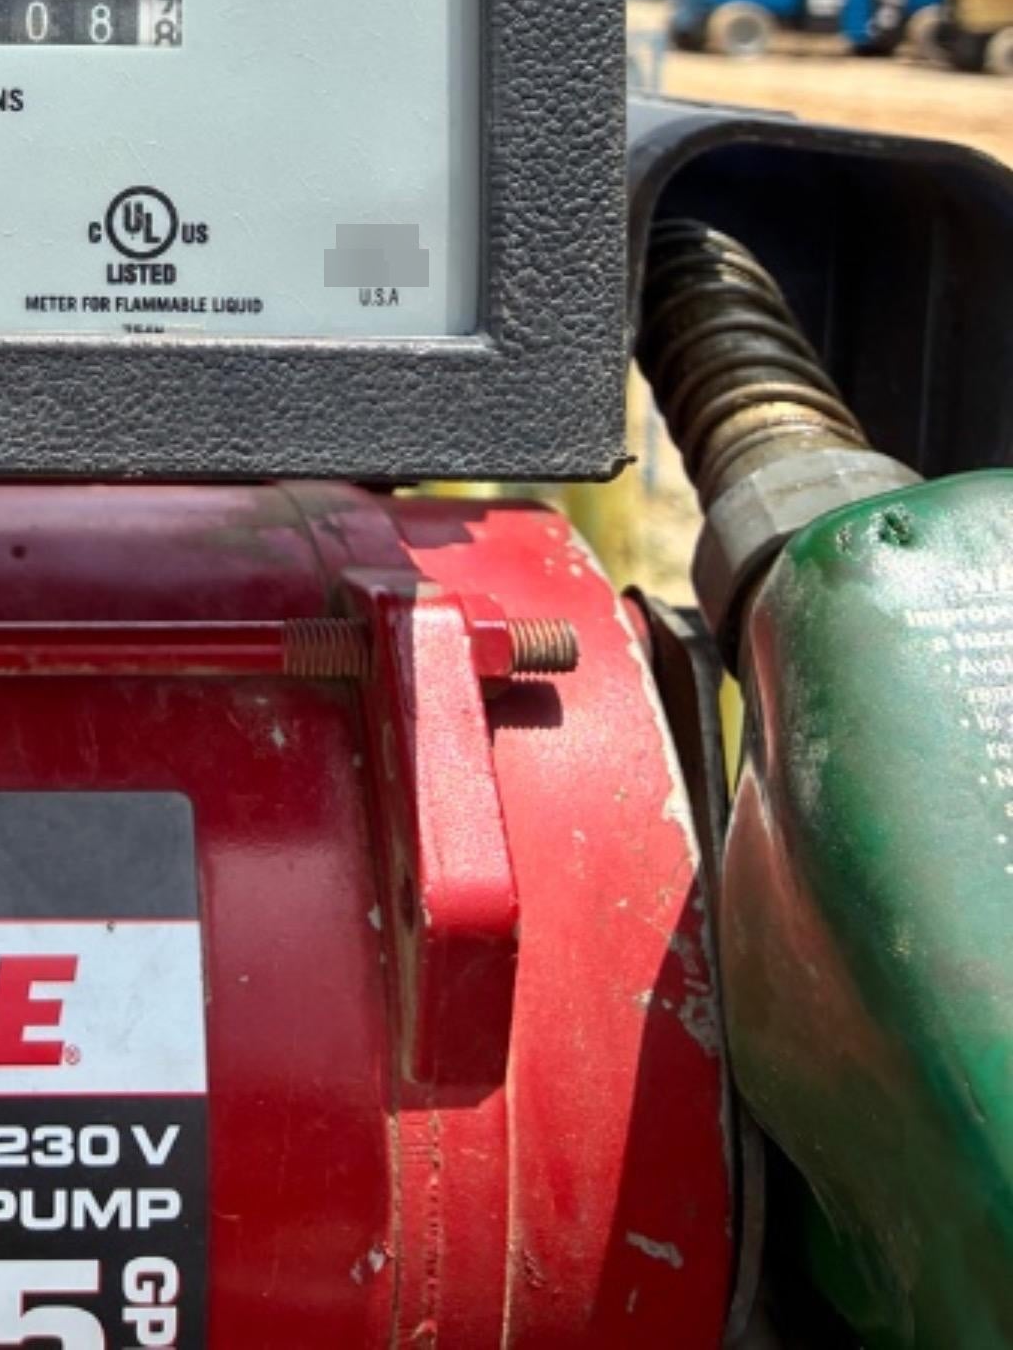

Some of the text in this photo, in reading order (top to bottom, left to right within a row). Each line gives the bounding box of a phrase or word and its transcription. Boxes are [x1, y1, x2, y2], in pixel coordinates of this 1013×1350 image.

[181, 222, 210, 245] US
[105, 263, 178, 286] LISTED
[25, 296, 264, 315] METER FOR FLAMMABLE LIQUID
[131, 1124, 181, 1167] V
[121, 1255, 179, 1350] GP
